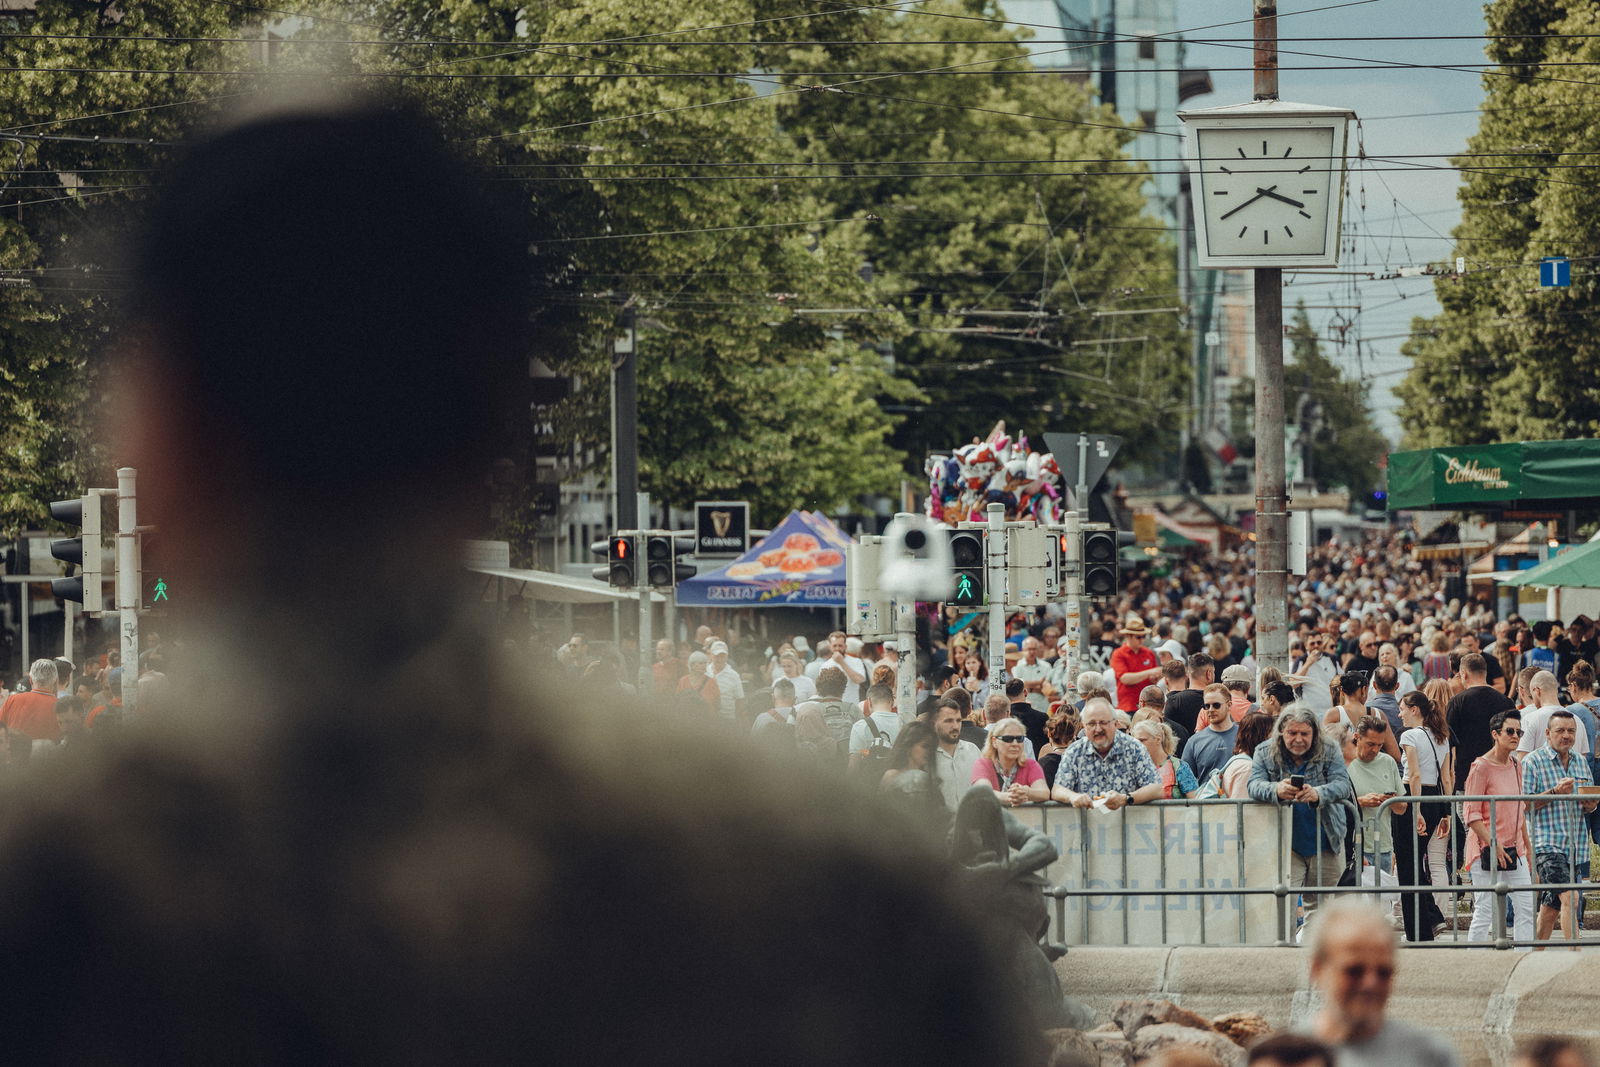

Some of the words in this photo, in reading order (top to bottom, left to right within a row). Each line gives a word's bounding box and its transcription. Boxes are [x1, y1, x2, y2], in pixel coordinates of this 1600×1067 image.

[1445, 457, 1502, 484] Eichbaum
[701, 536, 742, 547] GUINNESS
[707, 584, 757, 600] PARTY
